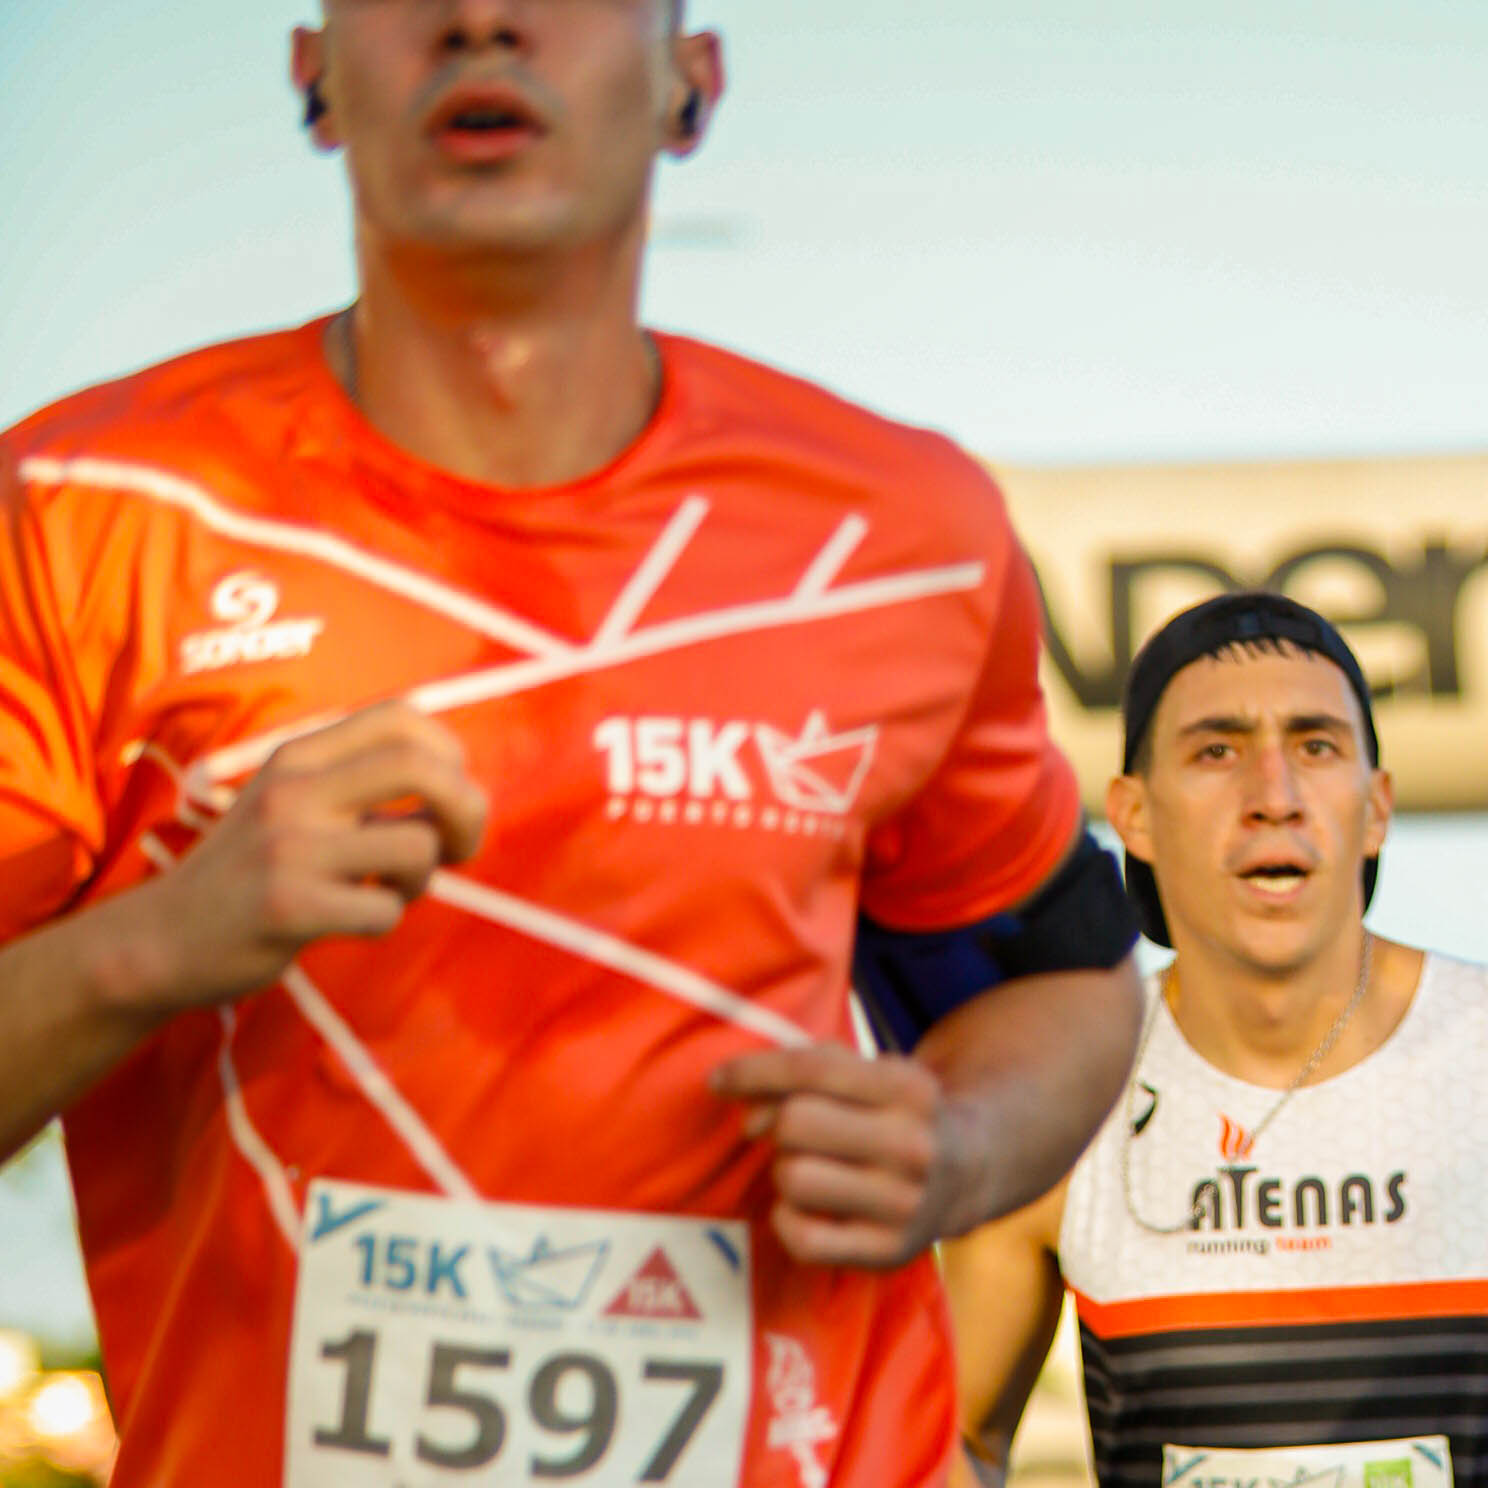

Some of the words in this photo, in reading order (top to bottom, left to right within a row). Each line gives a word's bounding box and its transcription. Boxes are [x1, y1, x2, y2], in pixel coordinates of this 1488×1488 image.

[594, 716, 751, 799] 15K
[355, 1232, 470, 1299] 15K
[312, 1326, 725, 1484] 1597
